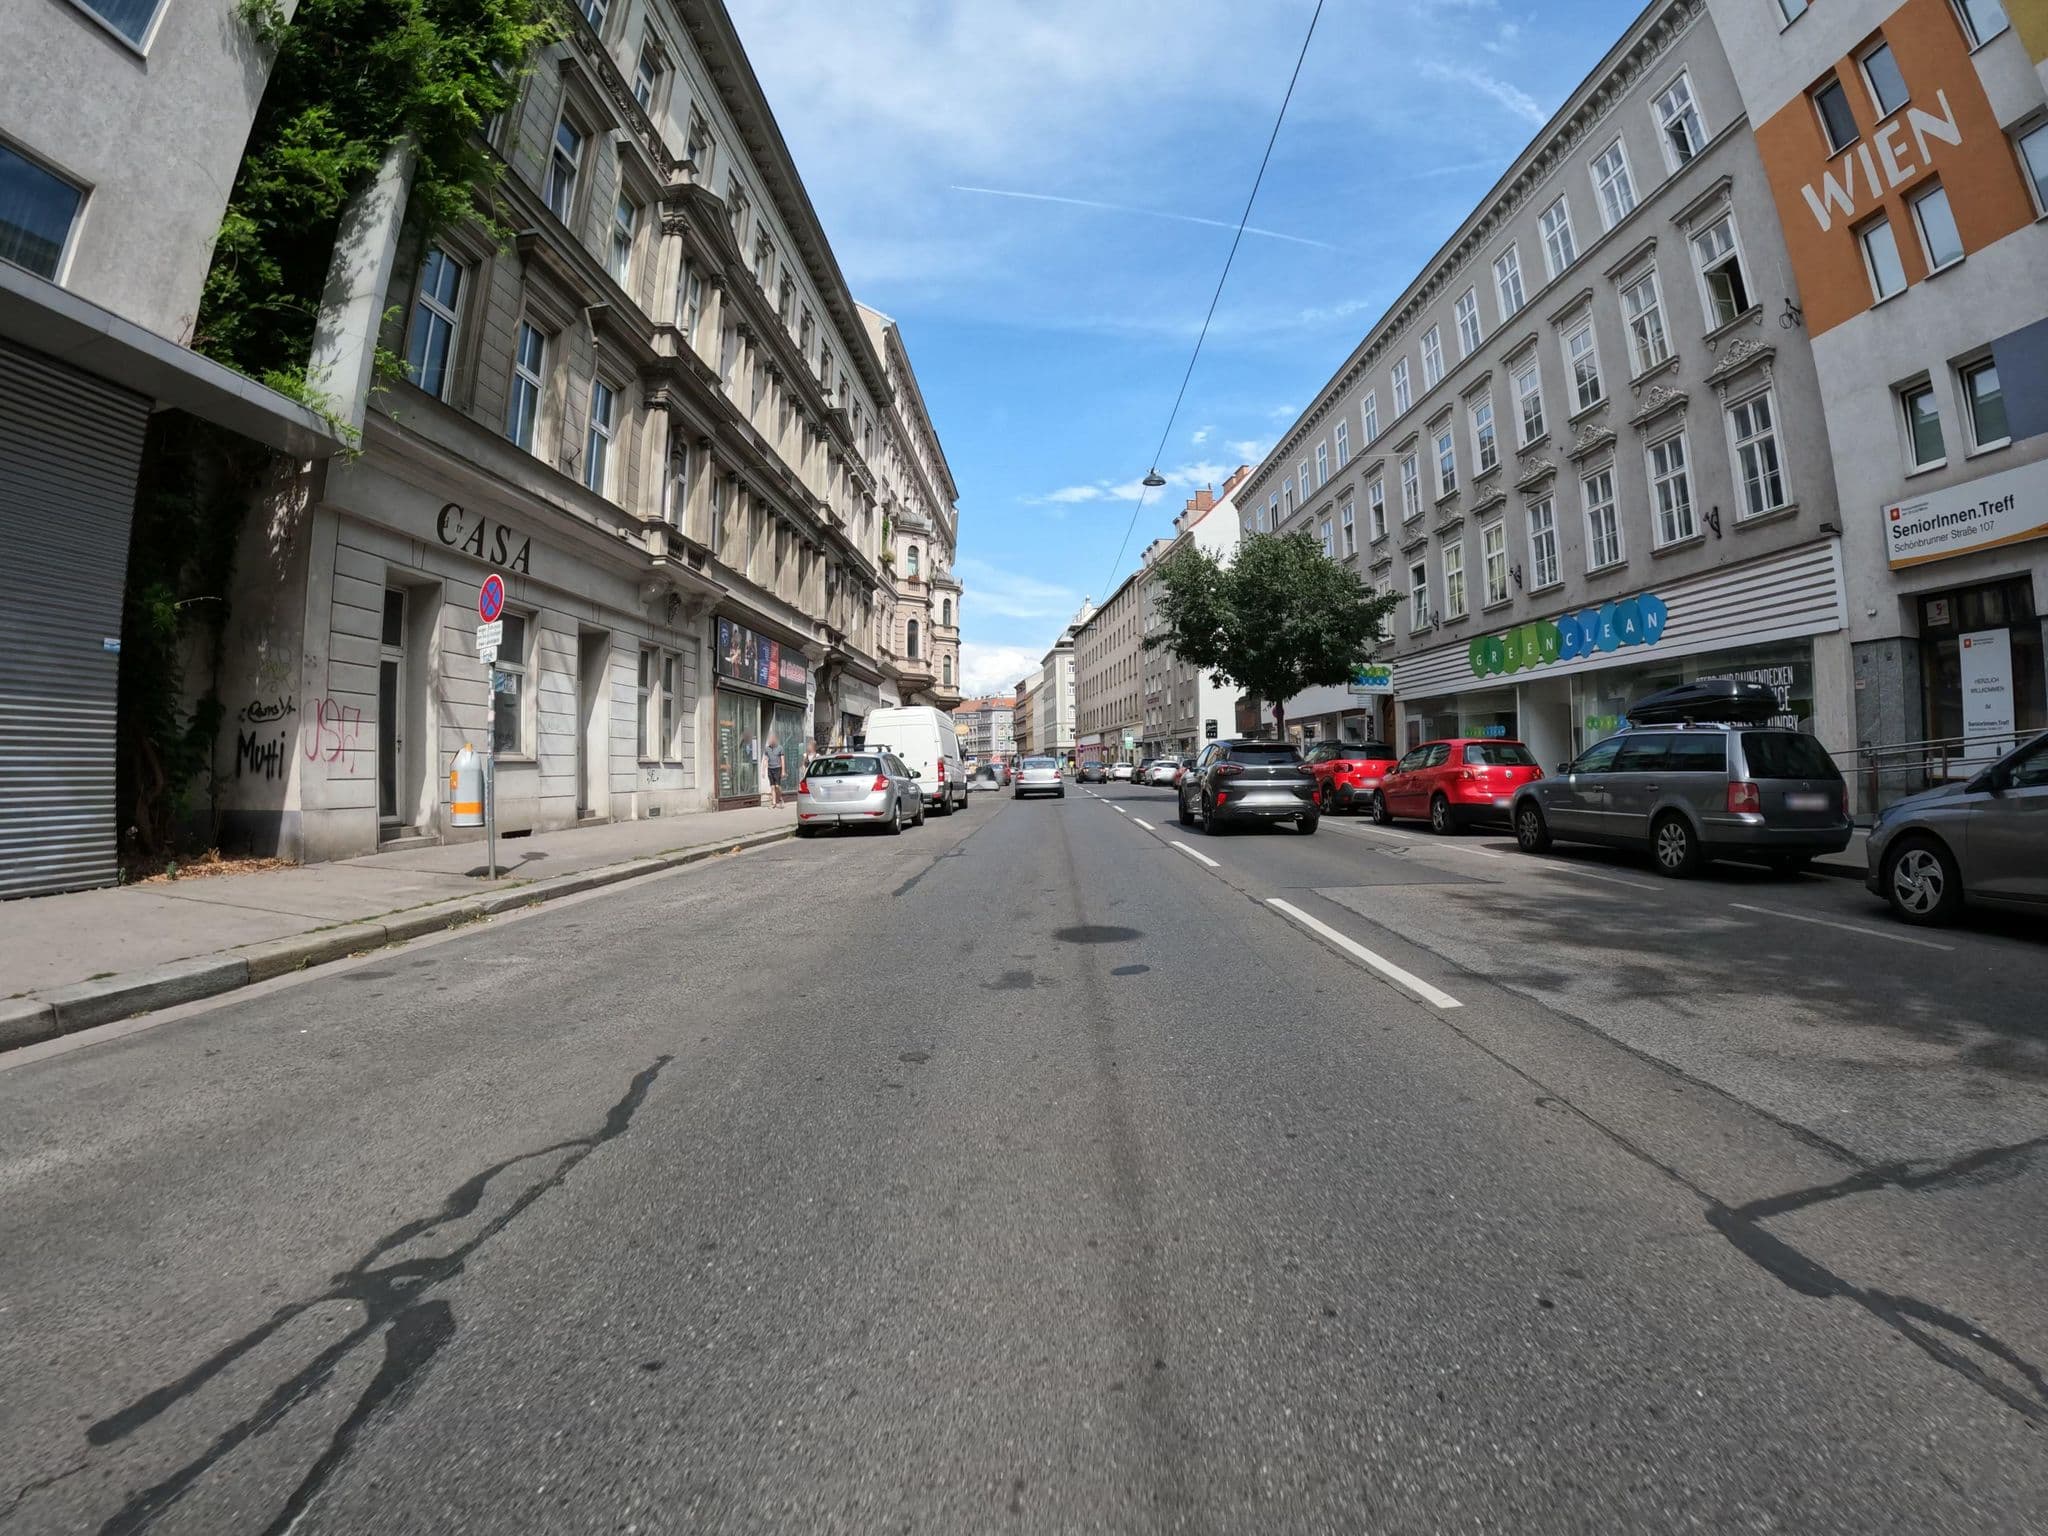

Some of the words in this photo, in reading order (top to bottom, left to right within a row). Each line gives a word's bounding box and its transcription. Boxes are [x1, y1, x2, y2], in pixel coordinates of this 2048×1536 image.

[1801, 89, 1962, 232] WIEN
[436, 502, 532, 575] CASA
[1892, 494, 2015, 539] SeniorInnen.Treff
[1894, 533, 1949, 553] Schönbrunner
[1951, 526, 1978, 540] Straße
[1979, 520, 1995, 533] 107
